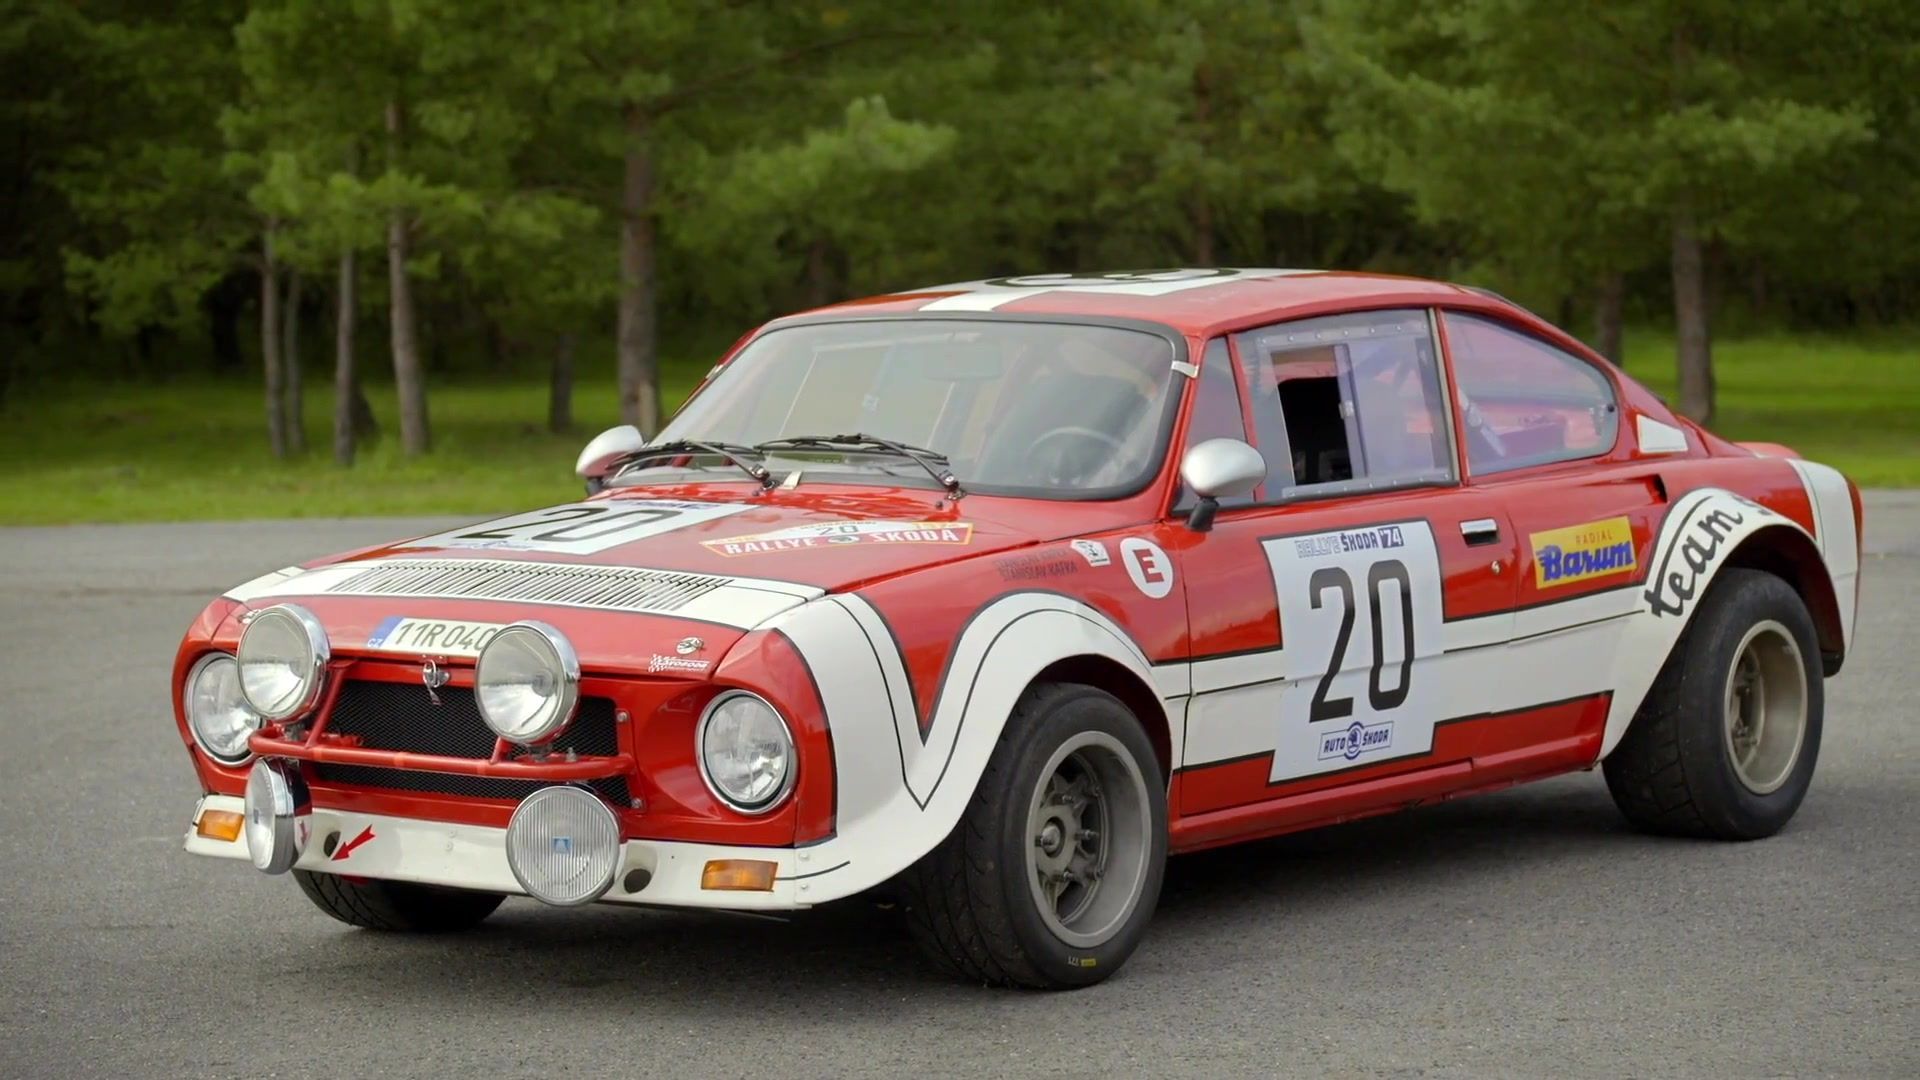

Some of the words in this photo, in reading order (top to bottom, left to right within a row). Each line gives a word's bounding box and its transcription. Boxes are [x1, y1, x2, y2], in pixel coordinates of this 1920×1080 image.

[454, 506, 683, 542] 20
[815, 525, 859, 536] 20
[1576, 529, 1613, 545] RADIAL
[723, 537, 818, 555] RALLYE
[1537, 541, 1634, 582] Barum
[1644, 496, 1744, 618] team
[1132, 548, 1165, 584] E
[1309, 559, 1415, 723] 20
[1324, 737, 1346, 753] AUTO
